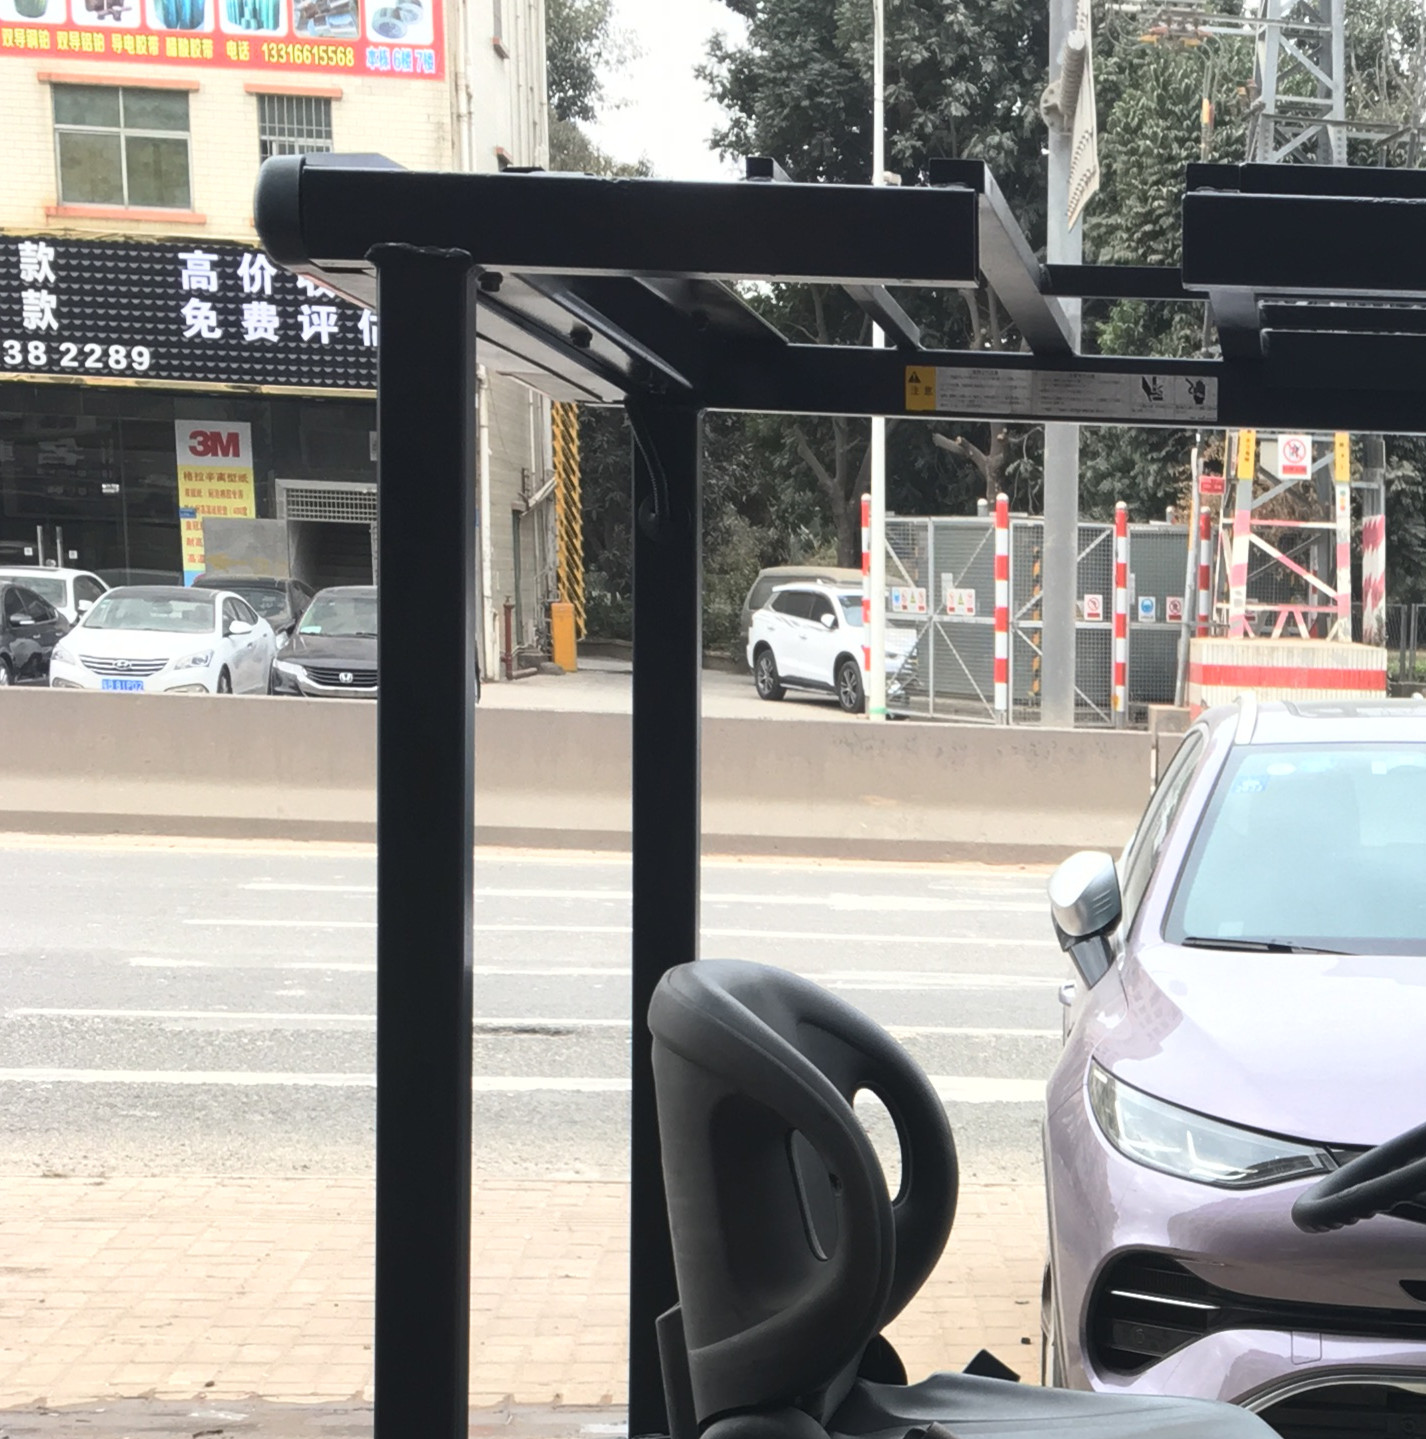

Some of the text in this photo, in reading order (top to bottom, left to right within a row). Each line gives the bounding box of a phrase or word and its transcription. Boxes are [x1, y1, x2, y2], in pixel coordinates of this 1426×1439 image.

[226, 40, 250, 61] 电话
[261, 43, 355, 67] 13316615568
[18, 241, 55, 283] 款
[21, 289, 59, 332] 款
[60, 342, 151, 371] 2289
[188, 430, 241, 458] 3M
